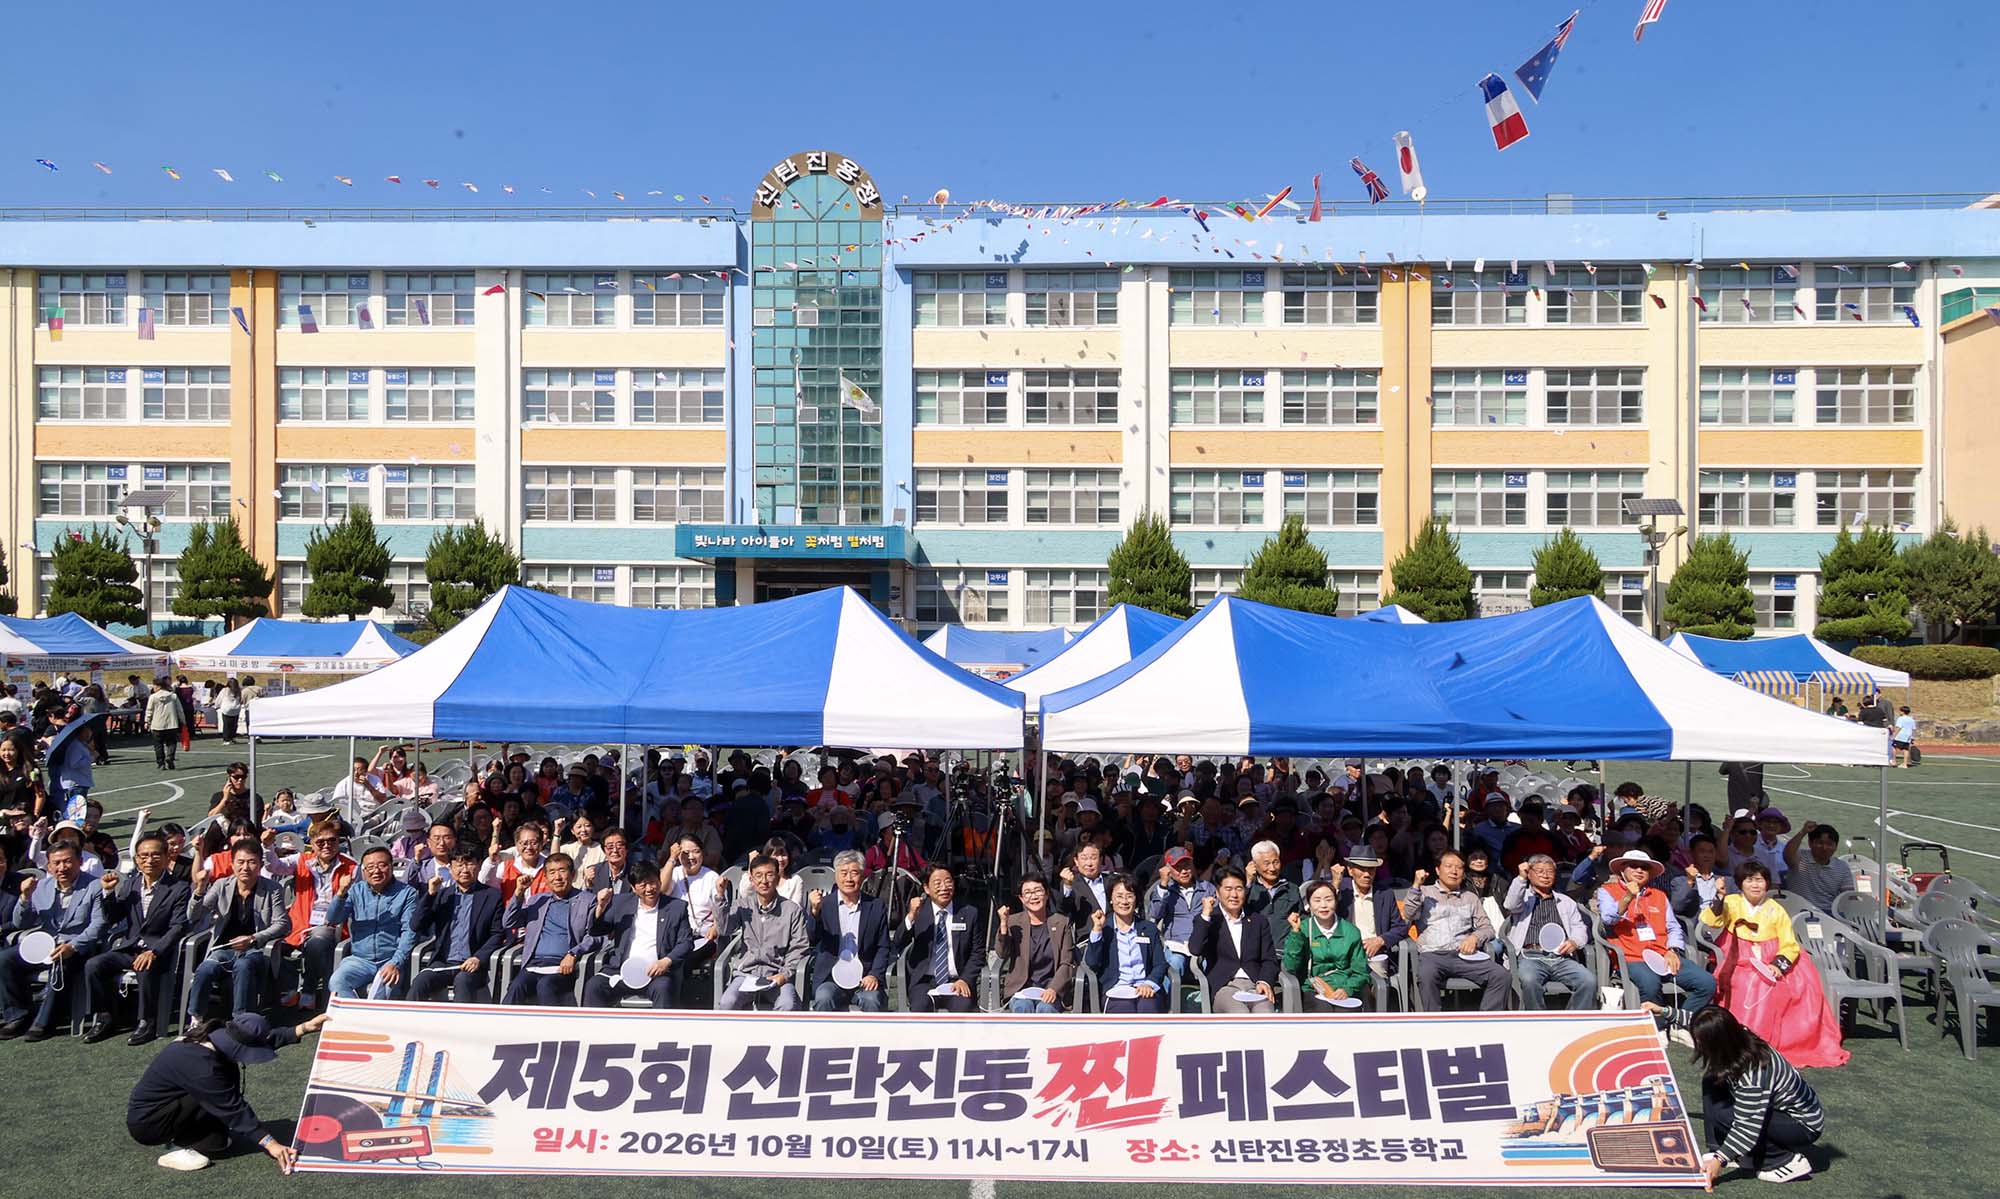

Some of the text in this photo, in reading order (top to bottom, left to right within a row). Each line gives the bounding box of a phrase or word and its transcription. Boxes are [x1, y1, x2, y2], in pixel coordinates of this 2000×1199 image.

[756, 151, 879, 205] 신탄진용정
[1246, 274, 1261, 283] 5-3
[108, 371, 124, 380] 2-2
[352, 372, 365, 381] 2-1
[990, 375, 1004, 383] 4-4
[1507, 374, 1524, 383] 4-2
[1776, 374, 1792, 382] 4-1
[1246, 377, 1261, 386] 4-3
[110, 468, 124, 476] 1-3
[352, 471, 365, 480] 1-2
[1246, 475, 1260, 483] 1-1
[1508, 475, 1523, 484] 2-4
[695, 535, 736, 547] 빛나라
[805, 535, 842, 549] 꽃처럼
[847, 535, 884, 548] 별처럼
[477, 1034, 1518, 1132] 제5회 신탄진동 찐 페스티벌
[533, 1126, 1468, 1163] 일시: 2026년 10월 10일(토) 11시~17시 장소: 신탄진용정초등학교
